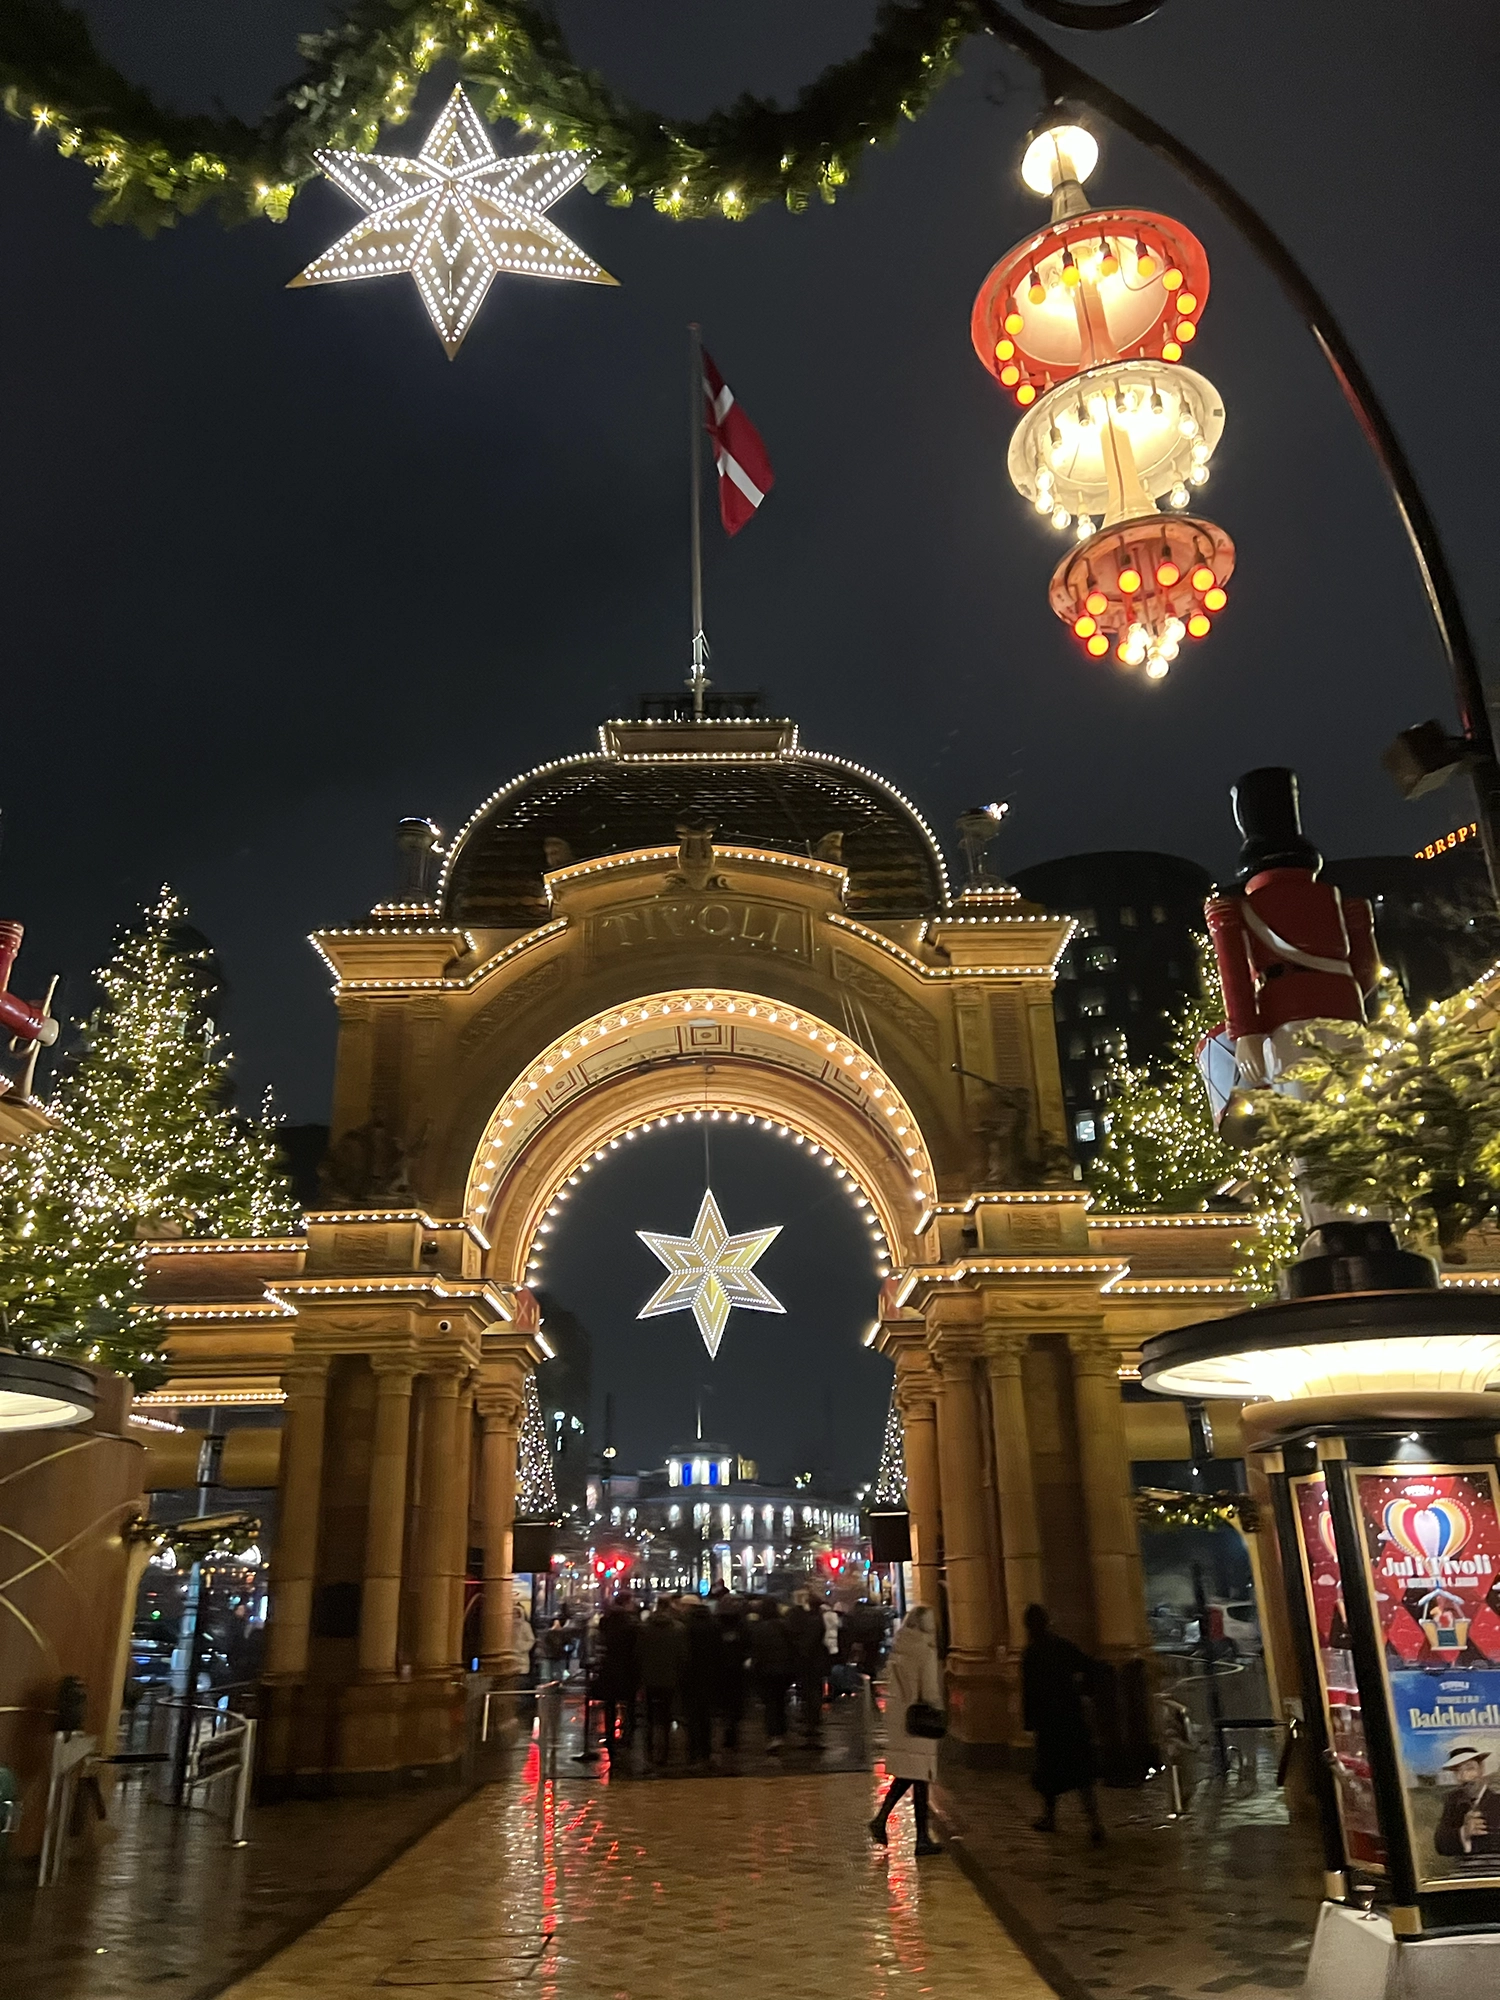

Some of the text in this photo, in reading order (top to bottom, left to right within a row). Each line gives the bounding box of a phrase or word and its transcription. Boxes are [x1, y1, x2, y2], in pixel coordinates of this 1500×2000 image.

[602, 904, 787, 946] TIVOLI
[1382, 1556, 1414, 1576] Jul
[1425, 1554, 1492, 1577] Tivoli
[1409, 1704, 1500, 1729] Badehotell
